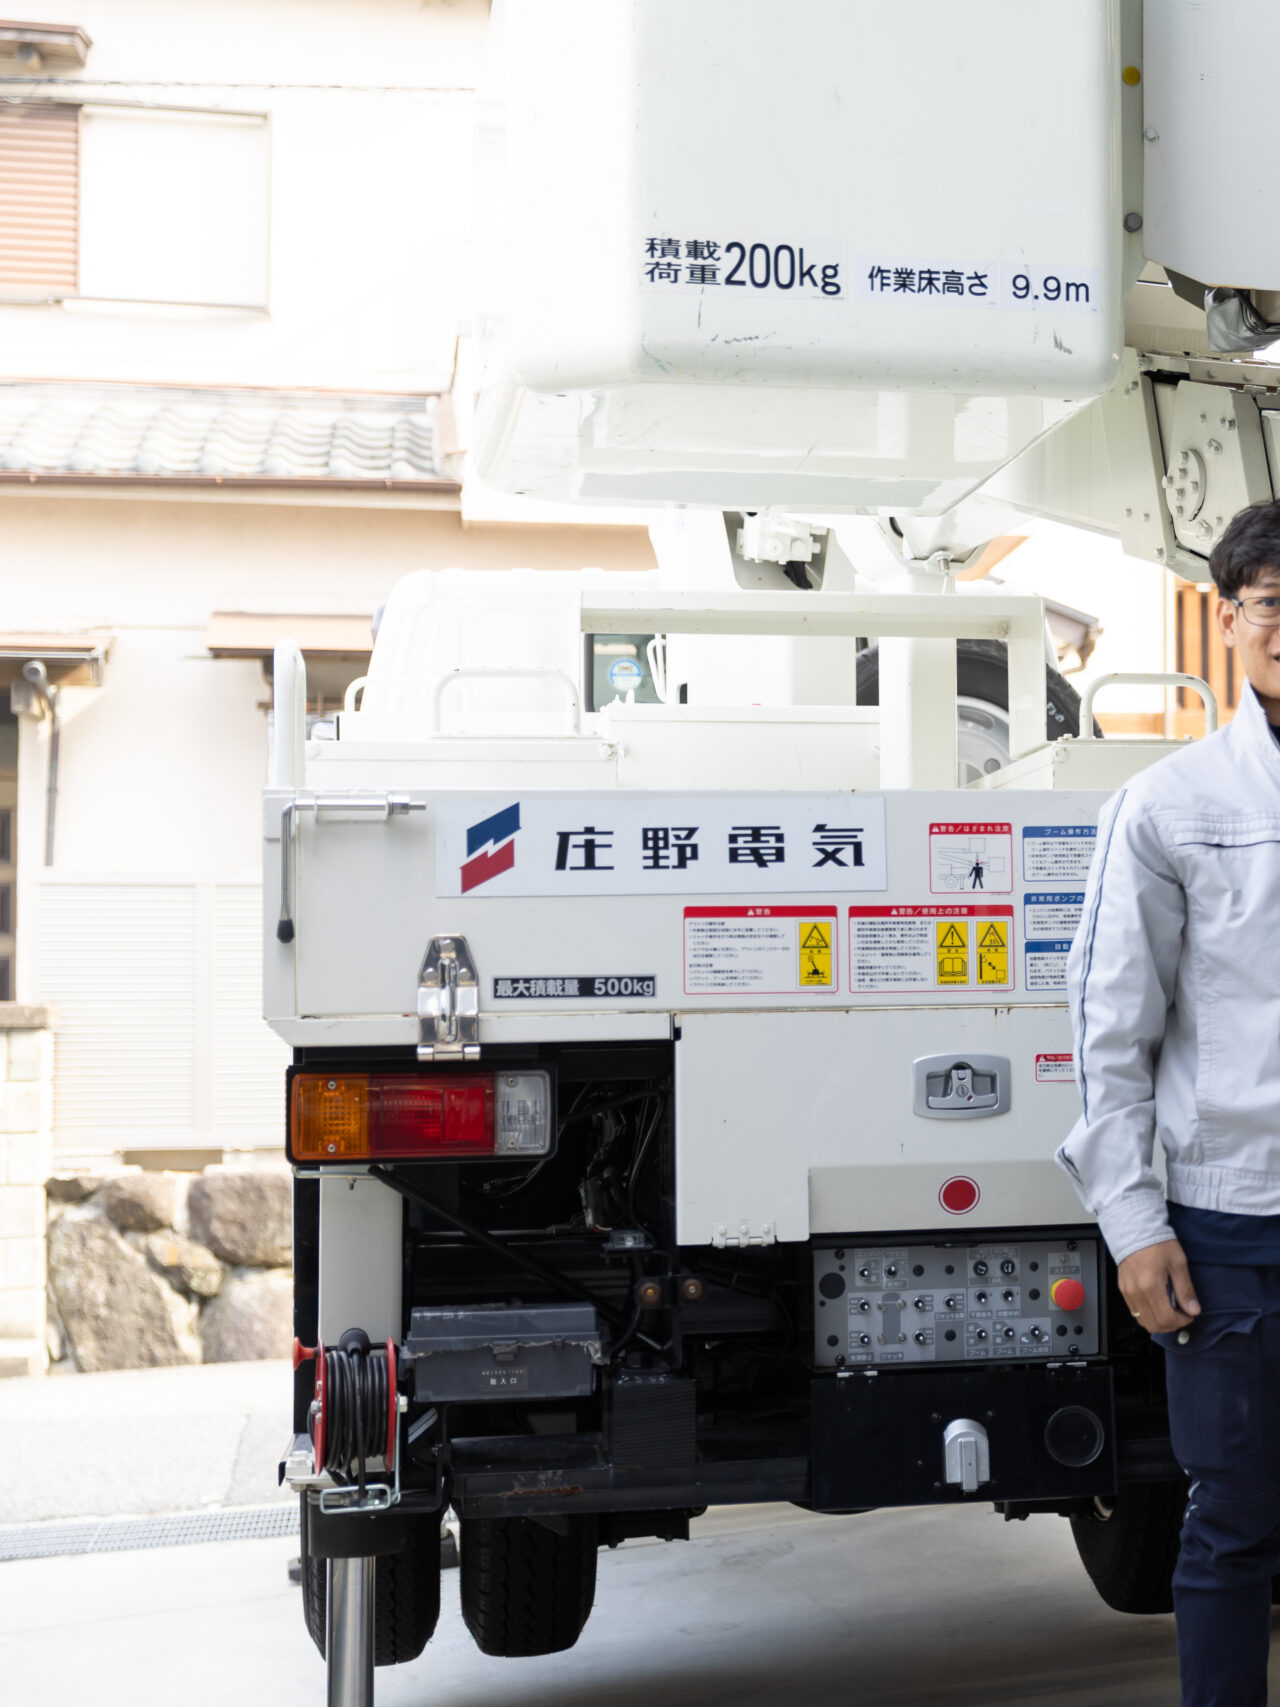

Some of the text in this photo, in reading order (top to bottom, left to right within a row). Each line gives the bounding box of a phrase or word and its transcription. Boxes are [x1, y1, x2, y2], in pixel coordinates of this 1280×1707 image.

[644, 237, 722, 261] 積載
[644, 262, 722, 287] 荷重
[723, 240, 842, 297] 200kg
[868, 264, 1091, 303] 作業床高さ 9.9m
[554, 823, 865, 871] 庄野電気
[495, 978, 655, 997] 最大積載量 500kg
